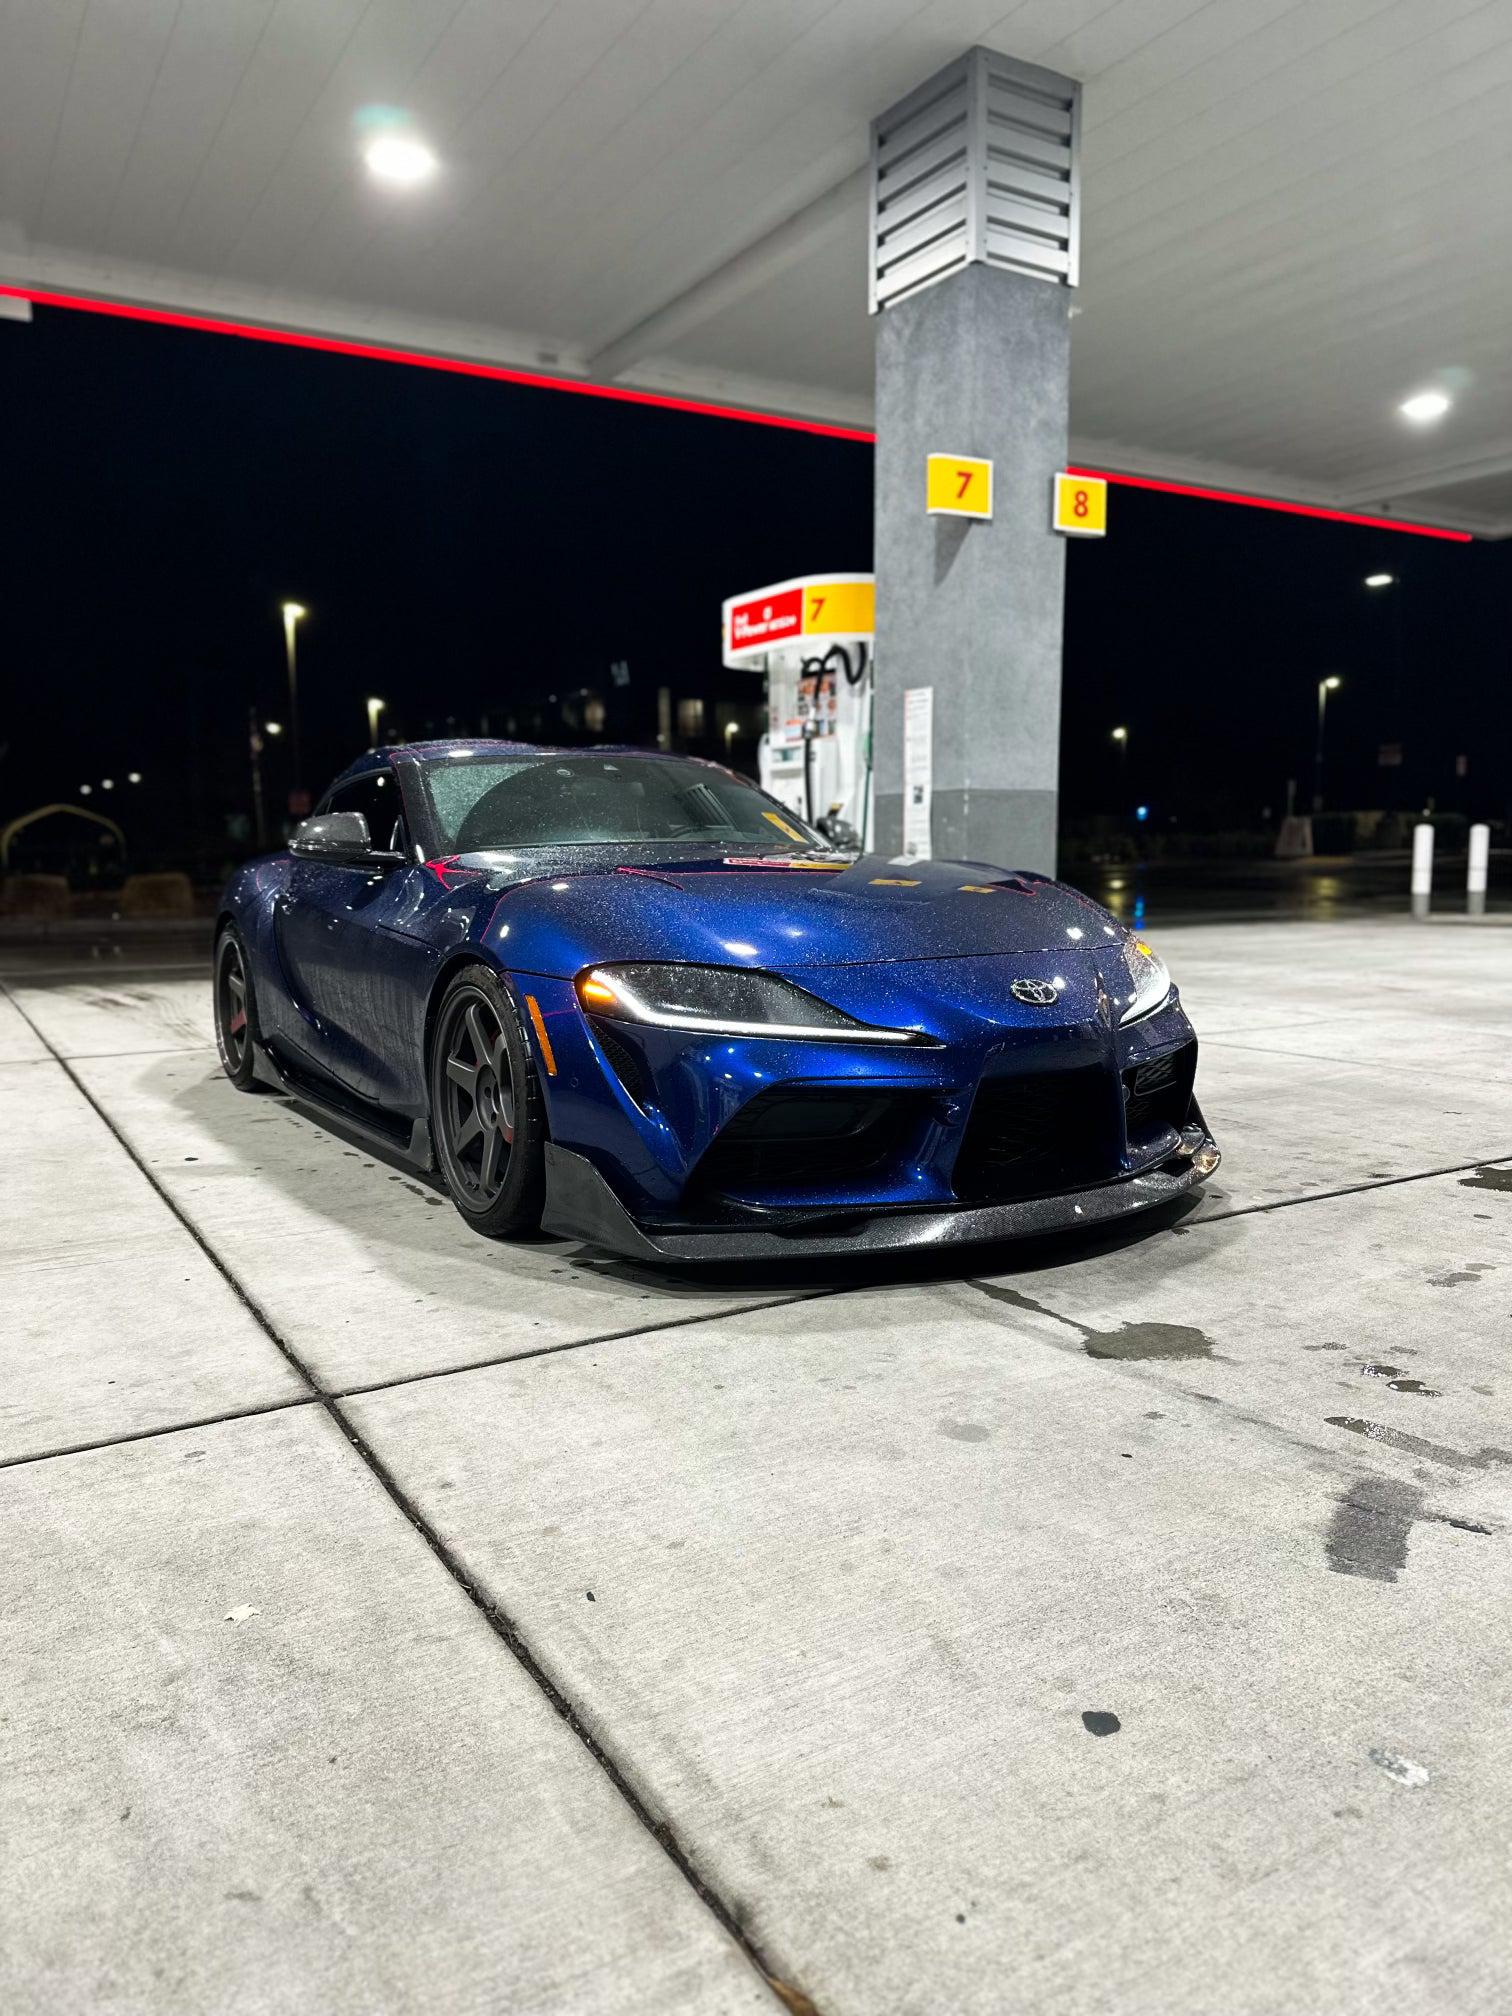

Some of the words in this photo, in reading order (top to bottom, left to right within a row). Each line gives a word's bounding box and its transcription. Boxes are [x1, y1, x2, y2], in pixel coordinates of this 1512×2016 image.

[956, 471, 973, 499] 7
[1073, 490, 1089, 518] 8
[810, 598, 826, 622] 7
